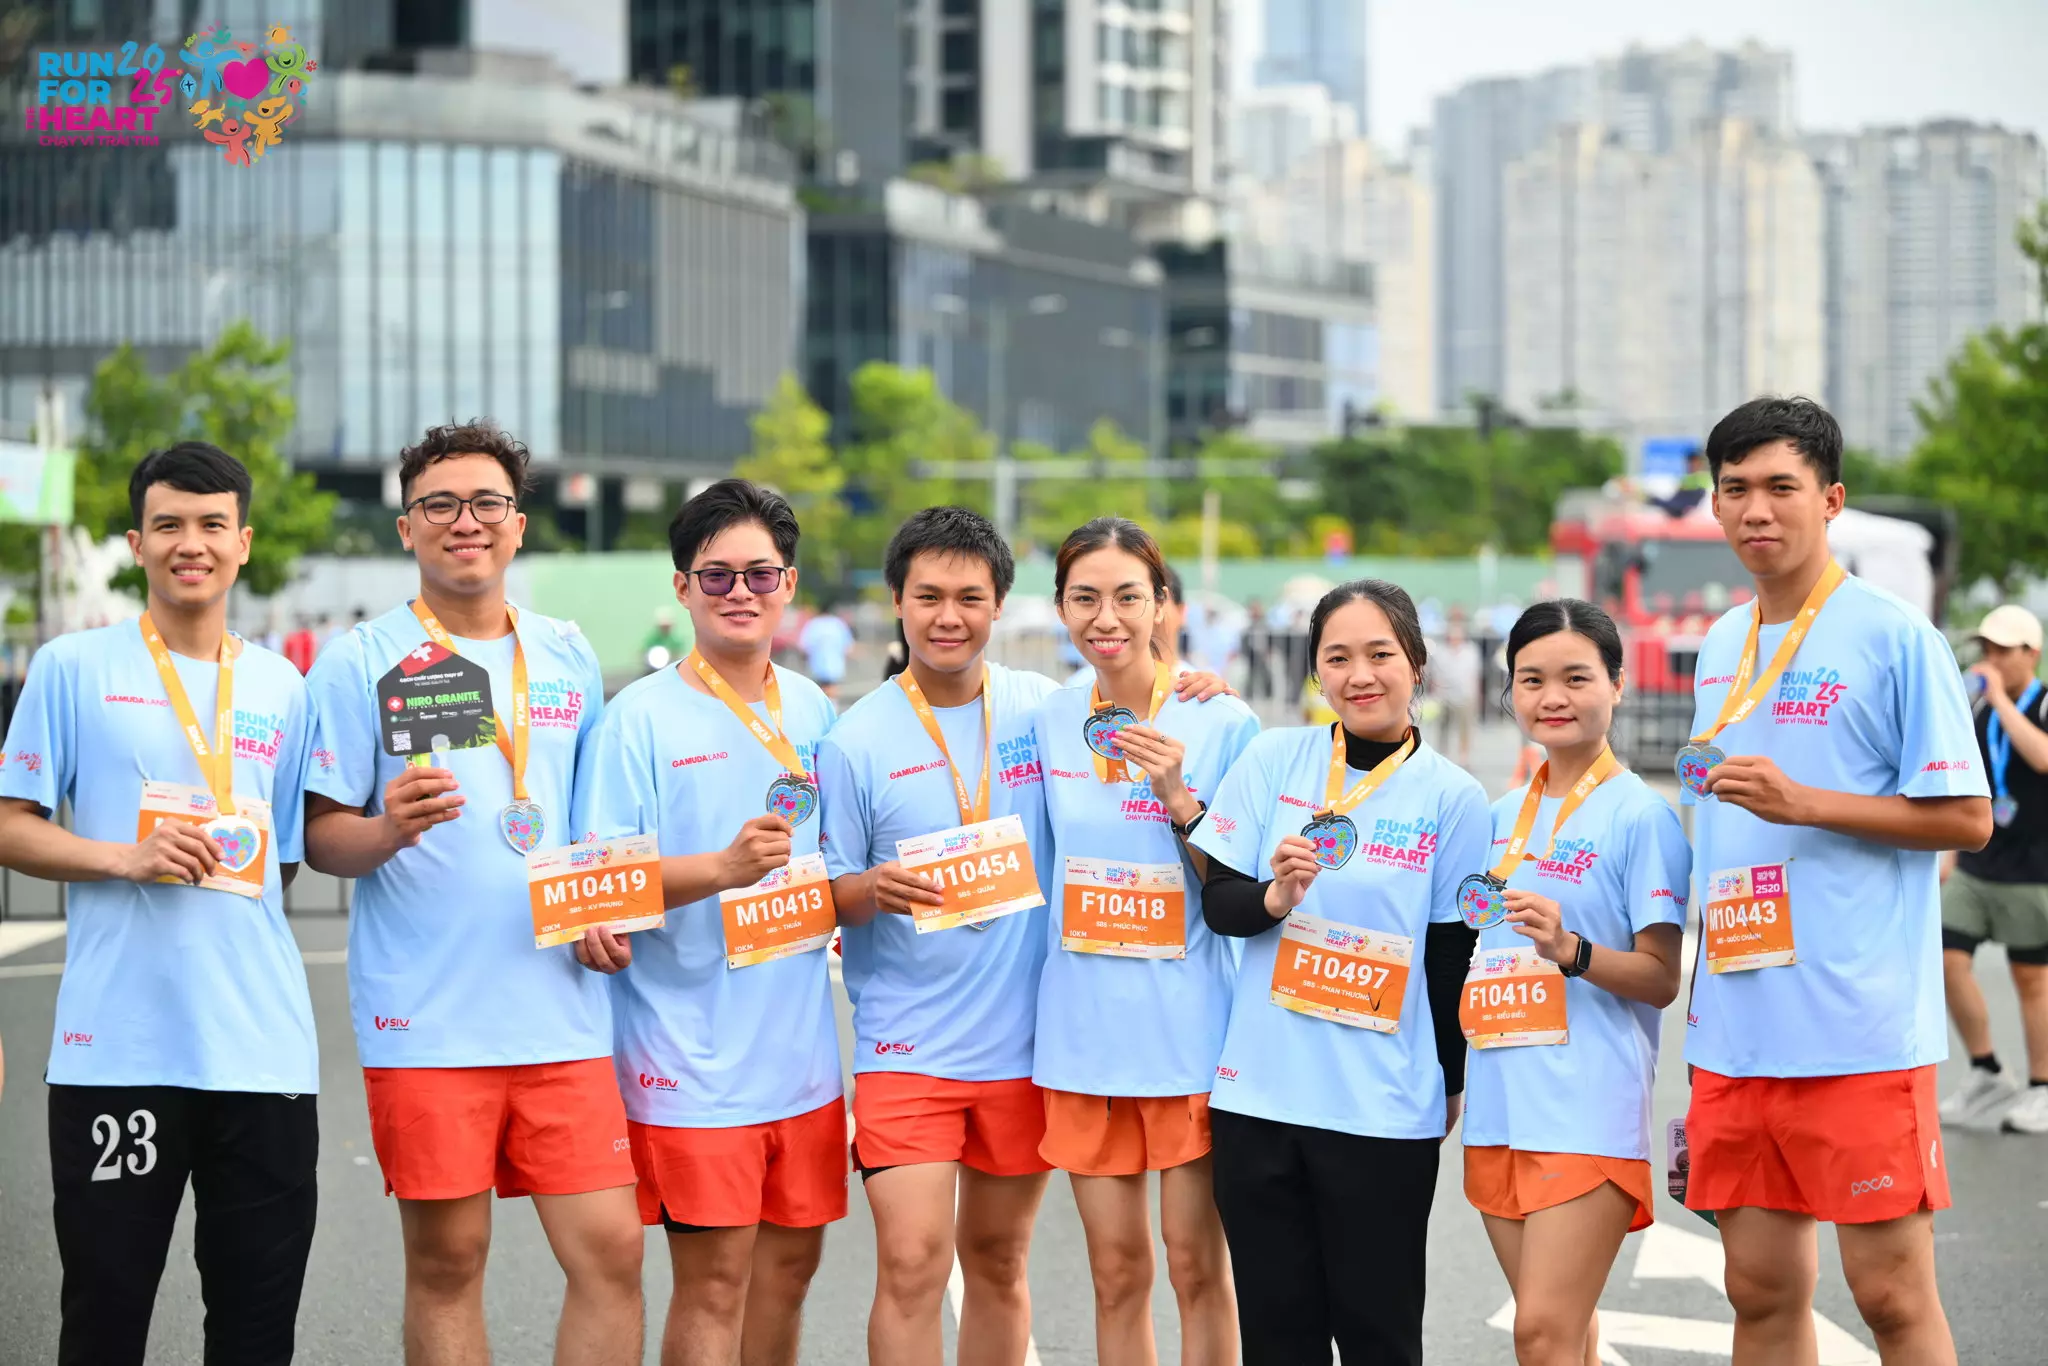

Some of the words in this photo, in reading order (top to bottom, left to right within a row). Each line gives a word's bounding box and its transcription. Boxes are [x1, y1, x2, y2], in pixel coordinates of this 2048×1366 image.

[1717, 675, 1735, 684] LAND
[1781, 672, 1813, 686] RUN
[1813, 667, 1840, 686] 20
[406, 696, 432, 707] NIRO
[435, 691, 480, 704] GRANITE
[530, 694, 562, 707] FOR
[1778, 687, 1808, 700] FOR
[1815, 682, 1848, 704] 25
[528, 707, 578, 722] HEART
[1776, 702, 1830, 717] HEART
[235, 710, 268, 727] RUN
[235, 724, 268, 741] FOR
[750, 720, 773, 743] 10KM
[997, 735, 1031, 756] RUN
[672, 755, 708, 768] GAMUDA
[708, 752, 728, 761] LAND
[1001, 749, 1032, 768] FOR
[889, 765, 926, 779] GAMUDA
[926, 760, 946, 770] LAND
[956, 777, 969, 809] 10KM
[1307, 802, 1324, 811] LAN
[1375, 819, 1412, 834] RUN
[1413, 817, 1436, 835] 20
[1372, 831, 1408, 847] FOR
[1417, 832, 1438, 853] 25
[1574, 838, 1594, 853] 20
[1369, 844, 1429, 865] HEART
[1551, 850, 1569, 862] OR
[1574, 849, 1598, 869] 25
[919, 850, 1020, 889] M10454
[1540, 860, 1585, 877] HEART
[544, 869, 647, 906] M10419
[1756, 884, 1780, 894] 2520
[736, 888, 822, 927] M10413
[921, 909, 942, 918] 10KM
[1082, 891, 1165, 920] F10418
[1710, 901, 1777, 932] M10443
[541, 923, 560, 933] 10KM
[735, 943, 753, 953] 10KM
[1326, 938, 1347, 947] HEART
[1293, 948, 1390, 989] F10497
[1278, 985, 1296, 996] 10KM
[1303, 980, 1316, 988] SBS
[1469, 981, 1547, 1009] F10416
[389, 1018, 410, 1027] SIV
[892, 1042, 915, 1053] SIV
[1220, 1067, 1238, 1078] SIV
[656, 1077, 678, 1088] SIV
[91, 1109, 157, 1182] 23
